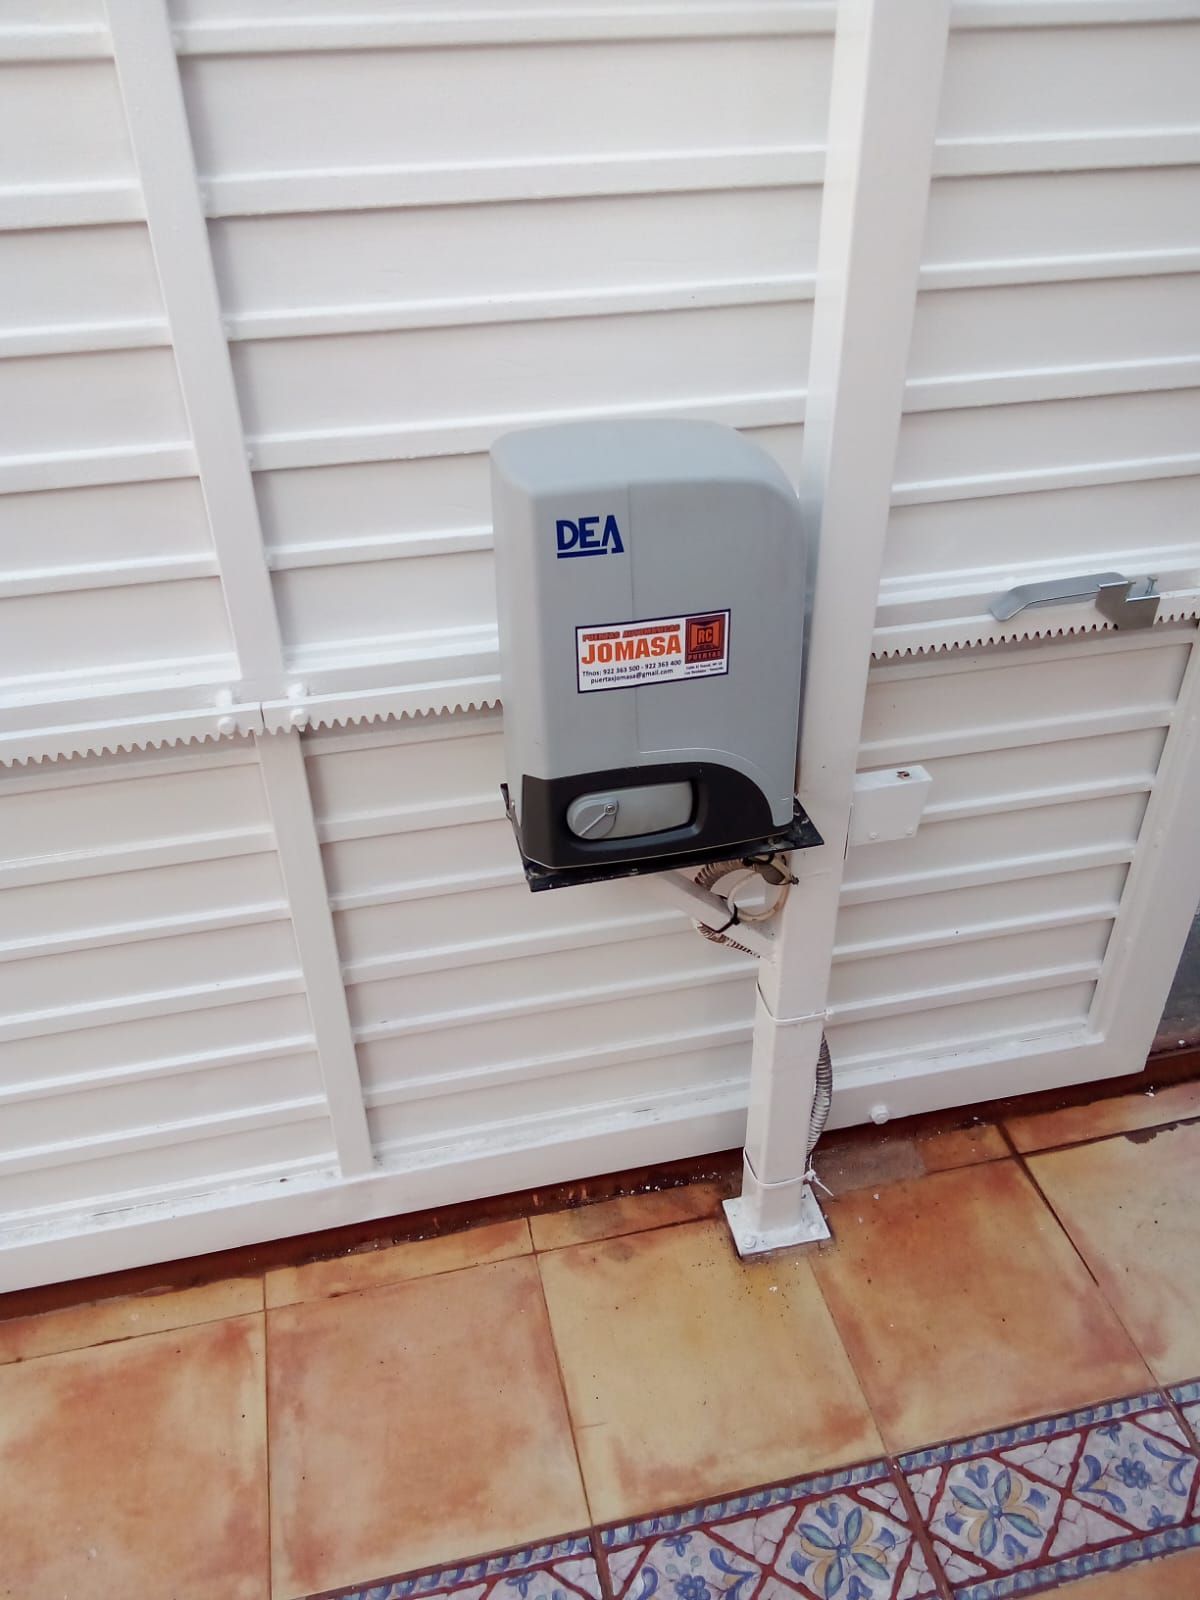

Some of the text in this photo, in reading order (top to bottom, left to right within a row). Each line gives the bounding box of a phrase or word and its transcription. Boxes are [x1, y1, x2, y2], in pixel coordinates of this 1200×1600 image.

[556, 515, 624, 554] DEA
[581, 634, 682, 665] JOMASA
[698, 628, 713, 643] RC
